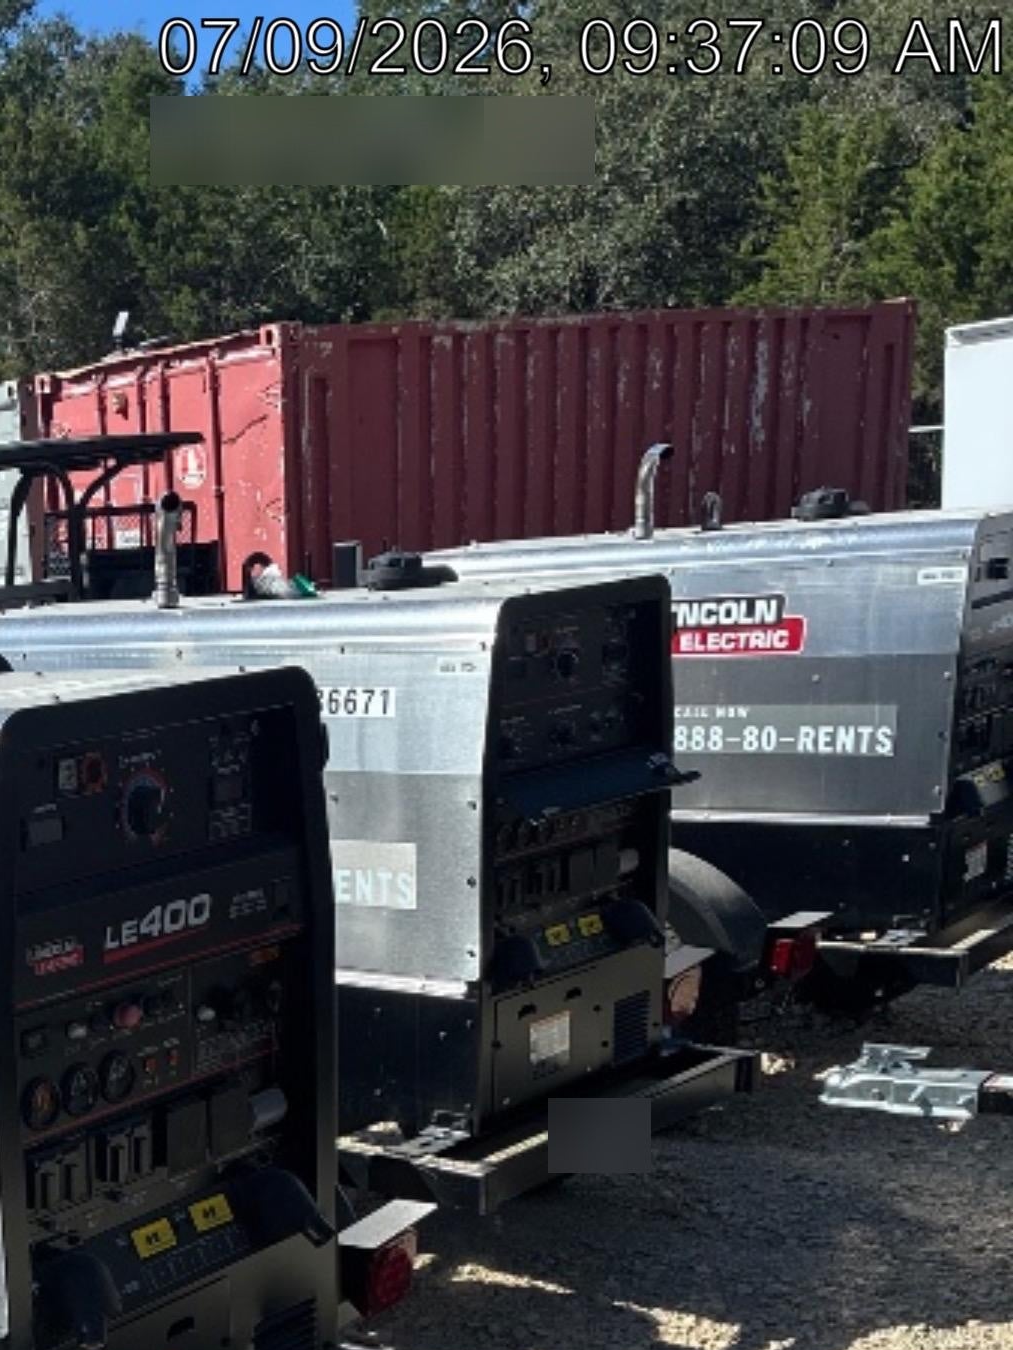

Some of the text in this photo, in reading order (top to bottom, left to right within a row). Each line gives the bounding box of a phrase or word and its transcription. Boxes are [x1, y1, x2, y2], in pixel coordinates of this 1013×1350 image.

[678, 629, 789, 652] ELECTRIC
[673, 725, 895, 754] 888-80-RENTS
[335, 869, 413, 907] ENTS
[104, 893, 211, 950] LE400
